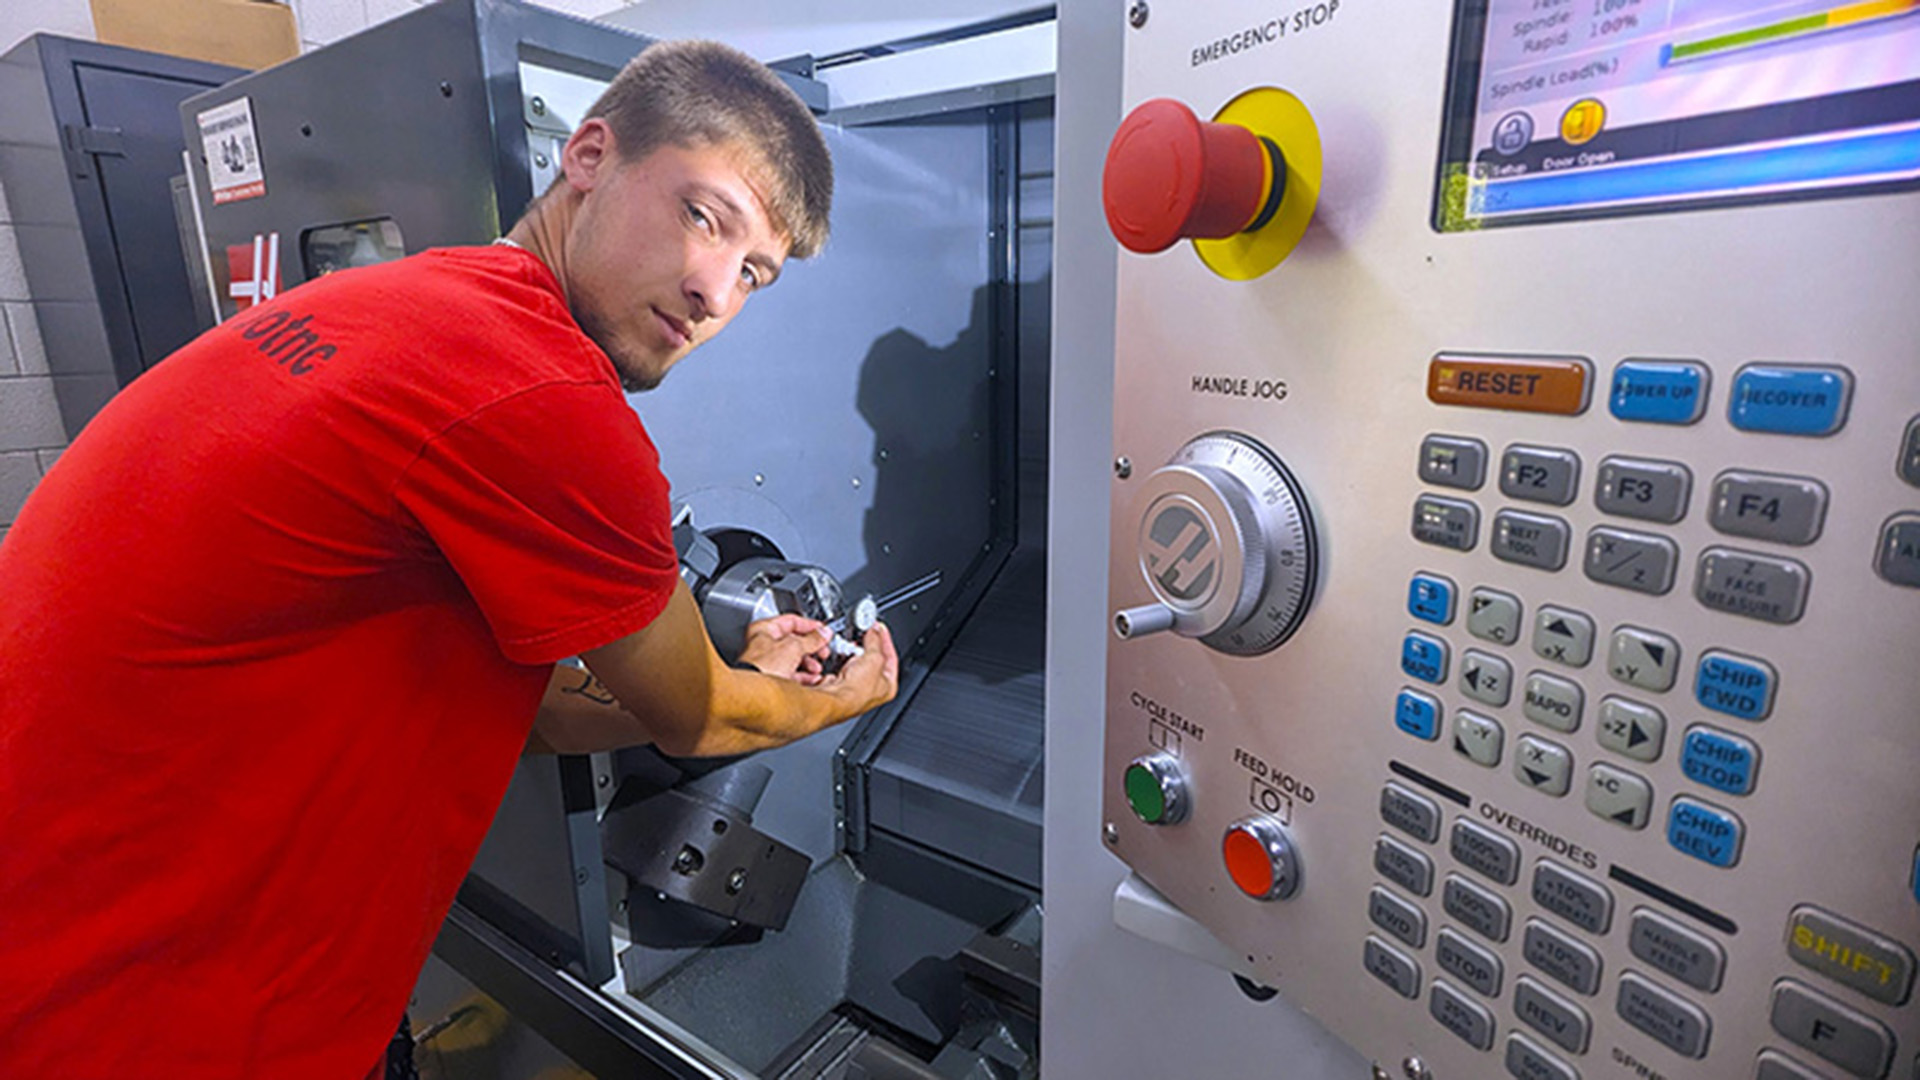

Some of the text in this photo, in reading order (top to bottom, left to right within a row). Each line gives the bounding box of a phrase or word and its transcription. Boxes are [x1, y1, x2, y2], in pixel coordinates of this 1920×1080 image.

[1192, 0, 1340, 67] EMERGENCY STOP
[1512, 11, 1571, 37] Spindle
[1522, 14, 1638, 53] Rapid 100%
[1490, 75, 1545, 99] Spindle
[1542, 156, 1575, 170] Door
[1577, 150, 1616, 167] Open
[1192, 376, 1289, 401] HANDLE JOG
[1457, 371, 1541, 396] RESET
[1671, 385, 1694, 399] UP
[1517, 464, 1549, 489] F2
[1617, 477, 1654, 504] F3
[1736, 494, 1782, 523] F4
[1509, 526, 1540, 540] NEXT
[1508, 540, 1539, 558] TOOL
[1725, 576, 1767, 595] FACE
[1705, 590, 1782, 619] MEASURE
[1703, 659, 1764, 690] CHIP
[1699, 684, 1757, 714] FWD
[1130, 691, 1205, 742] CYCLE START
[1692, 736, 1746, 764] CHIP
[1234, 748, 1316, 804] FEED HOLD
[1685, 758, 1744, 788] STOP
[1480, 802, 1598, 871] OVERRIDES
[1675, 808, 1730, 839] CHIP
[1675, 831, 1723, 858] REV
[1642, 928, 1700, 966] HANDLE
[1793, 924, 1894, 985] SHIFT
[1441, 947, 1490, 982] STOP
[1525, 1000, 1568, 1035] REV
[1811, 1019, 1837, 1041] F
